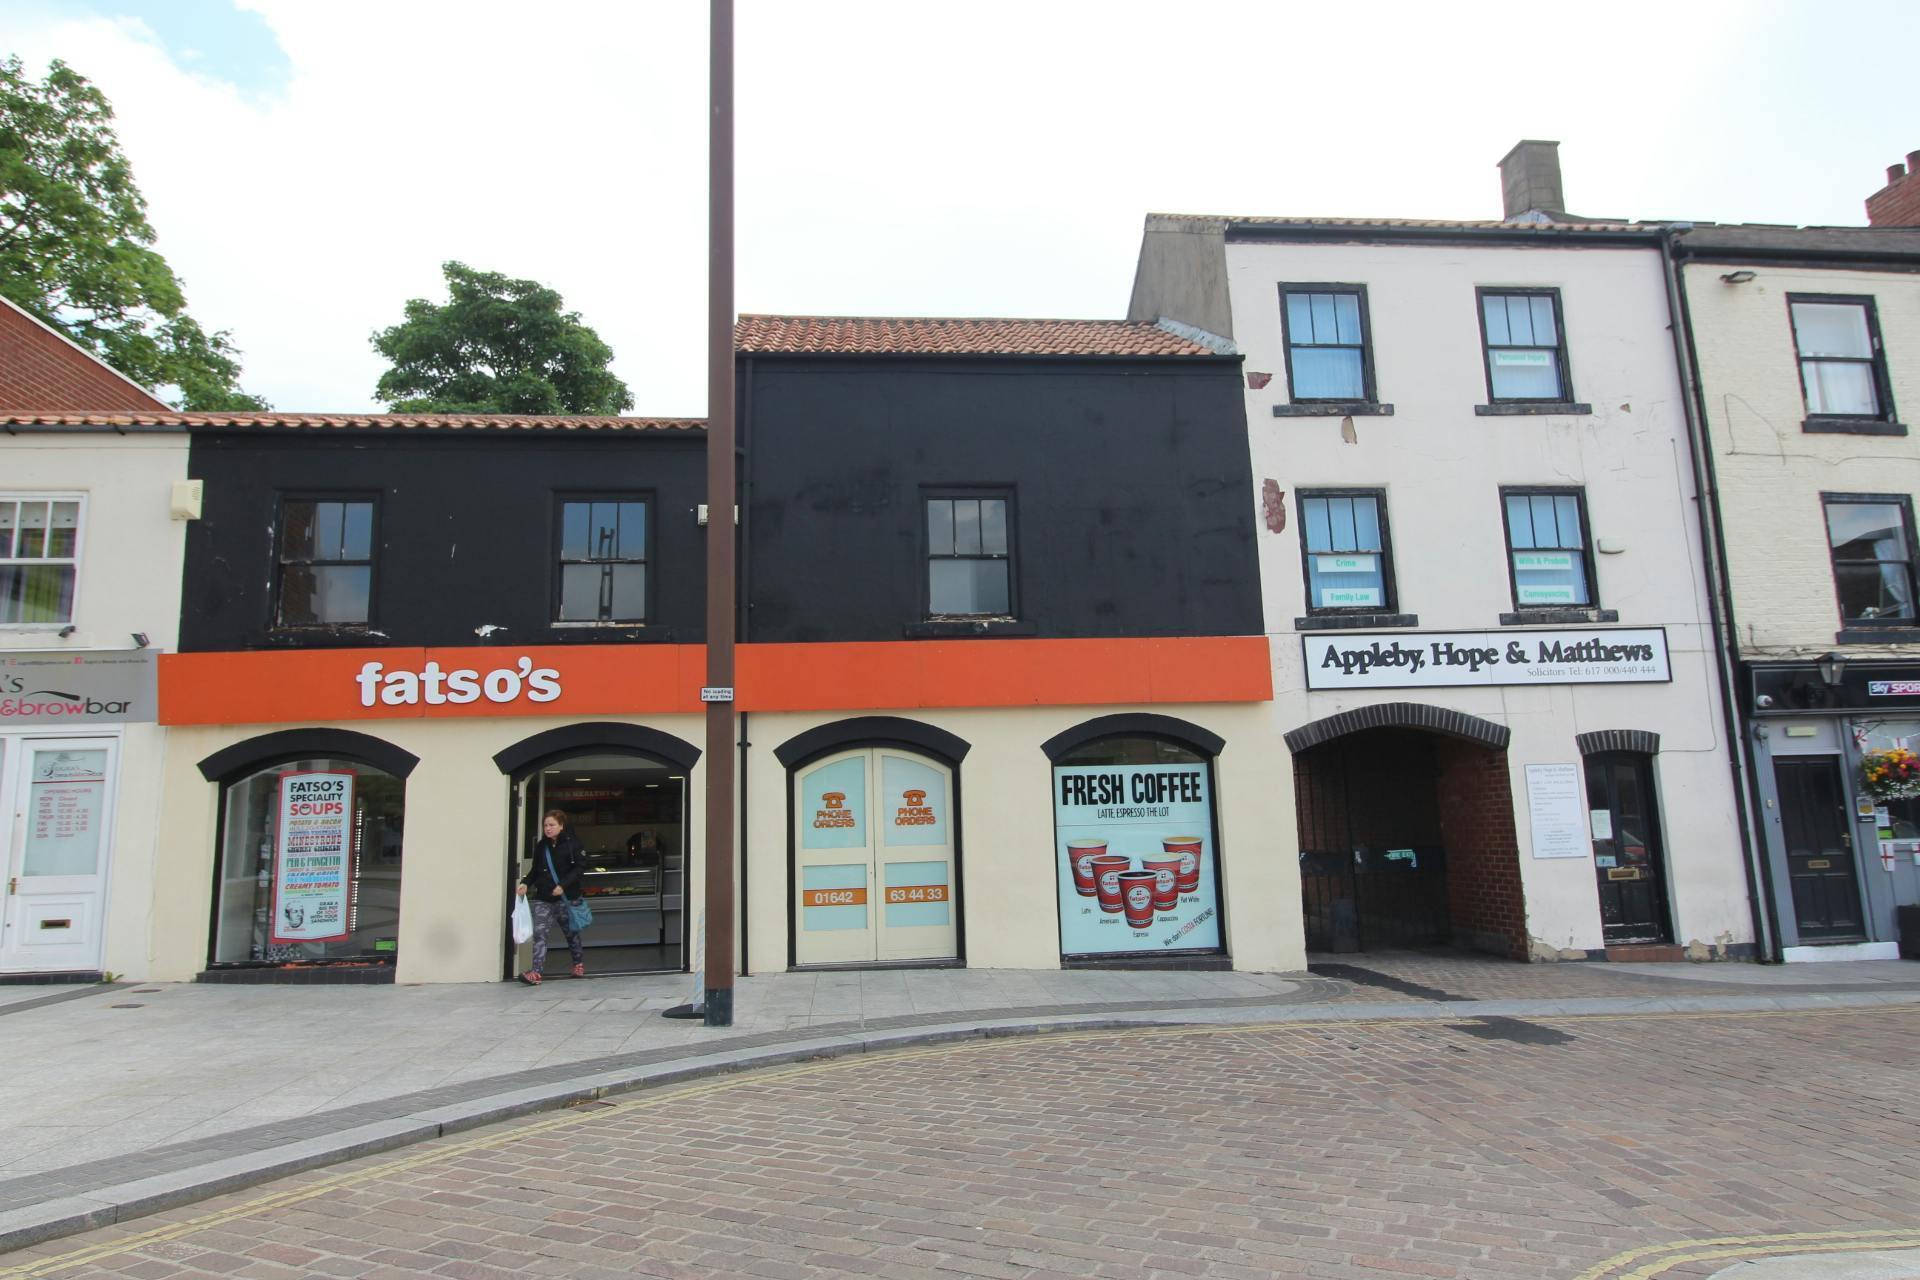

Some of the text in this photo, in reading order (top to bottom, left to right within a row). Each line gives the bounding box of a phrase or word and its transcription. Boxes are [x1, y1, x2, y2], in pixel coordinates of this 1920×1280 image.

[1335, 559, 1357, 568] Crime
[1330, 592, 1370, 603] Family Law
[1321, 637, 1654, 675] Appleby, Hope & Matthews
[1527, 667, 1566, 677] Solicitors
[1585, 666, 1600, 675] 617
[1640, 665, 1656, 674] 444
[355, 656, 562, 707] fatso's
[290, 780, 344, 793] FATSO'S
[1061, 771, 1202, 806] FRESH COFFEE
[290, 792, 343, 803] SPECIALITY
[290, 802, 343, 817] SOUPS
[816, 809, 852, 819] PHONE
[897, 806, 933, 817] PHONE
[1116, 807, 1145, 819] ESPRESSO
[1146, 806, 1158, 817] THE
[1158, 806, 1169, 817] LOT
[813, 818, 856, 829] ORDERS
[895, 815, 936, 826] ORDERS
[288, 834, 342, 847] MINESTRONE
[814, 891, 853, 904] 01642
[890, 888, 943, 902] 63 44 33
[1163, 938, 1173, 947] We
